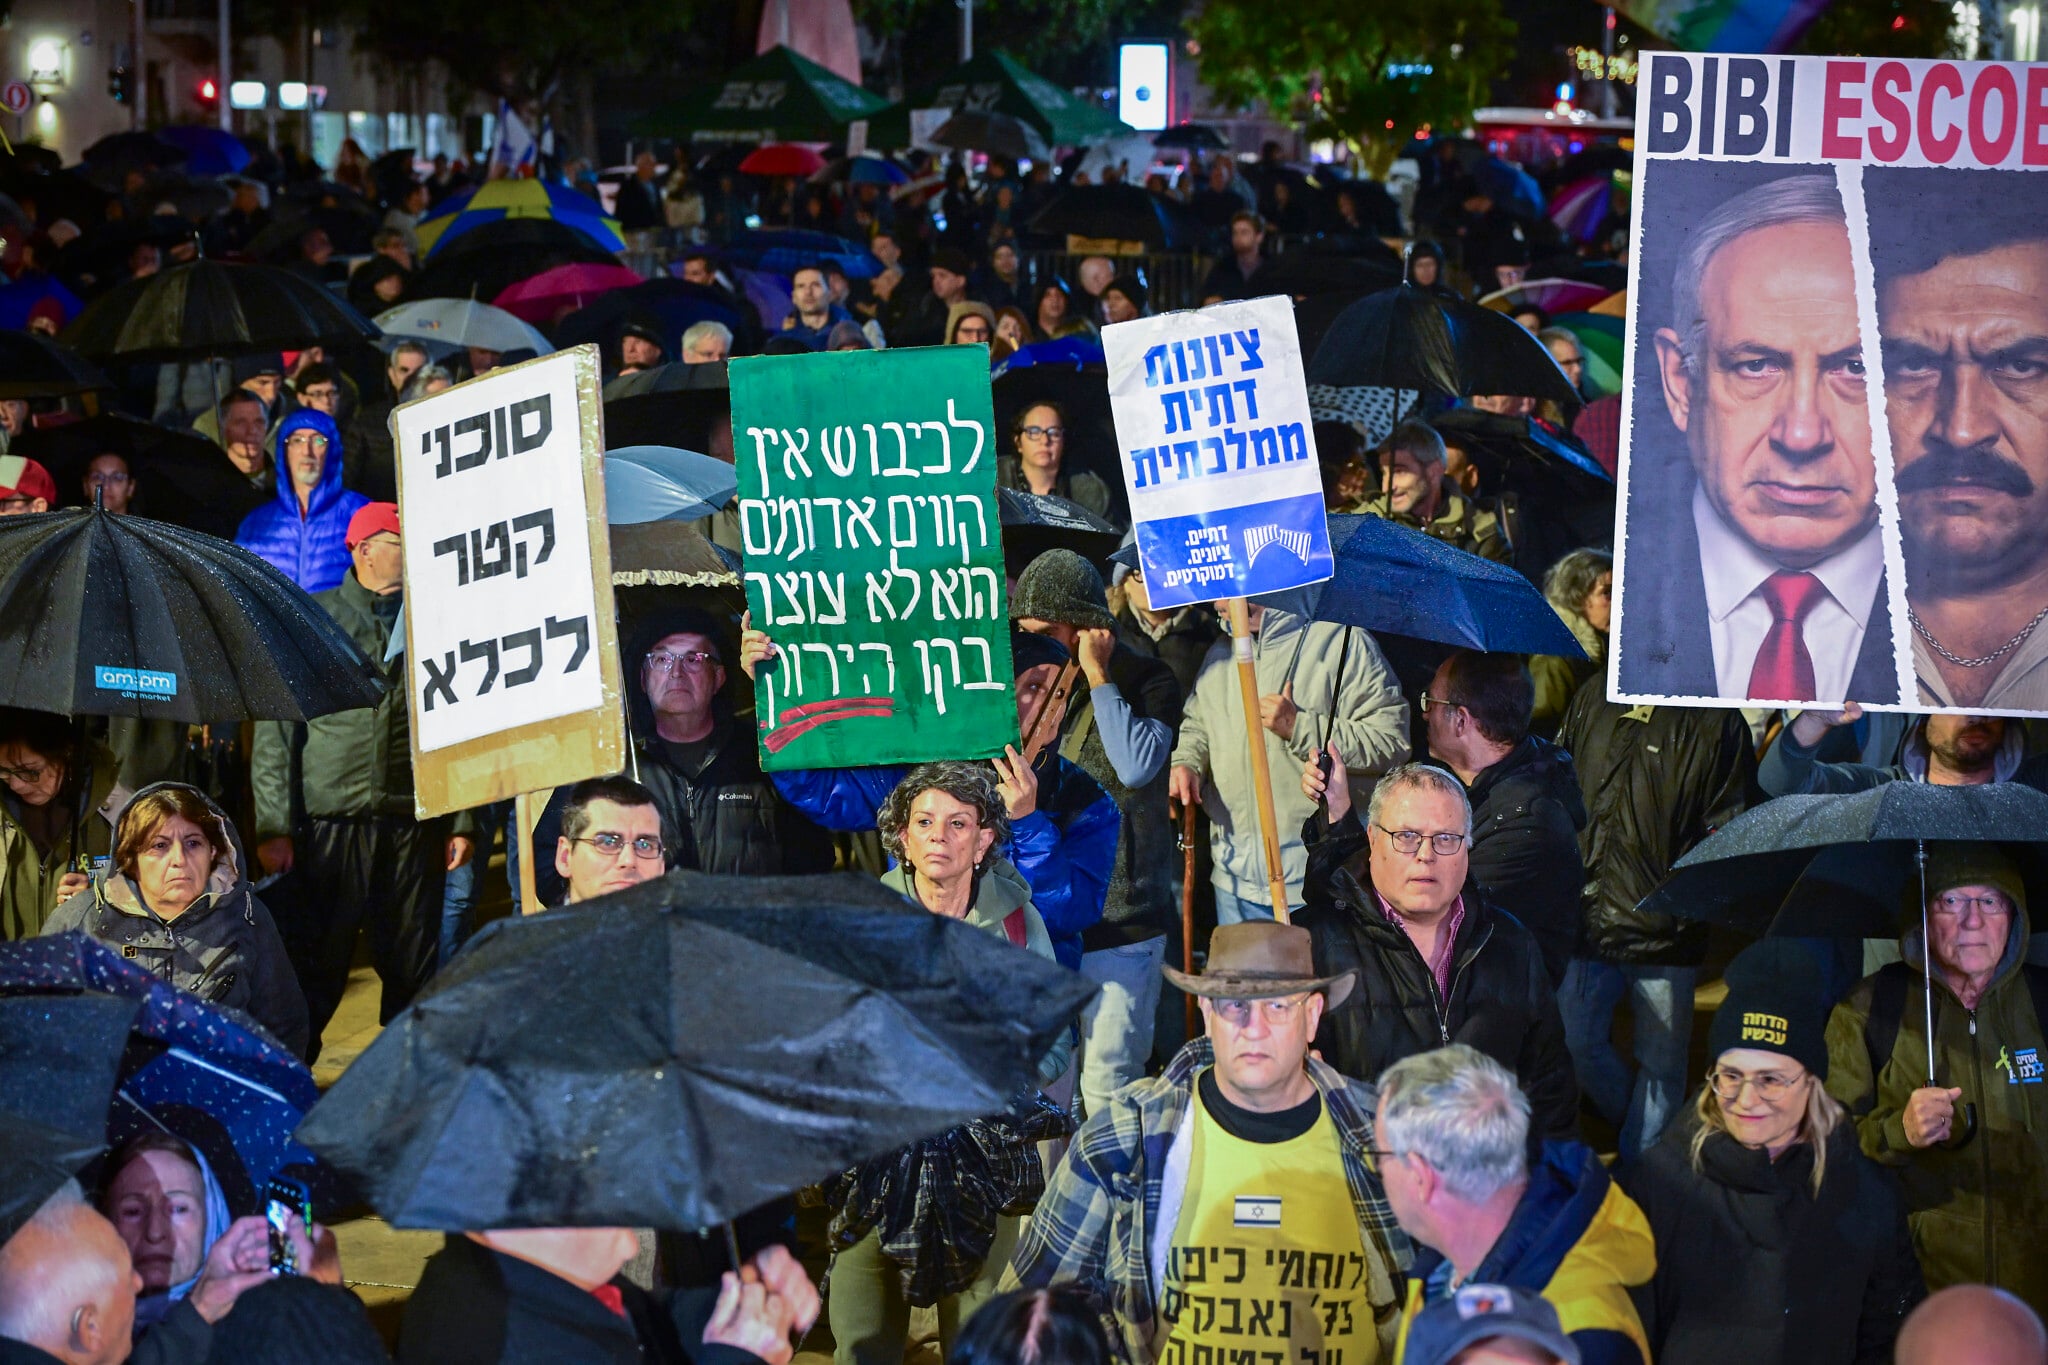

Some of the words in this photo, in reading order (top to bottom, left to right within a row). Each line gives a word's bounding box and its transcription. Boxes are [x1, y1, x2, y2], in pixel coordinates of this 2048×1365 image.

[1646, 55, 1795, 158] BIBI
[1142, 327, 1264, 388] ציונות
[421, 392, 553, 480] סוכני
[1160, 378, 1260, 434] דתית
[746, 426, 813, 499] אין
[820, 398, 985, 478] לכיבוש
[1129, 422, 1309, 489] ממלכתית
[432, 507, 556, 587] קטר
[739, 494, 882, 562] אדומים
[887, 494, 988, 564] קווים
[1184, 524, 1228, 547] דתיים.
[1187, 543, 1232, 566] ציונים.
[744, 570, 847, 626] עוצר
[865, 548, 921, 623] לא
[929, 566, 999, 621] הוא
[1162, 563, 1235, 588] דמוקרטים.
[421, 614, 590, 713] לכלא
[912, 637, 1007, 715] בקו
[139, 693, 171, 702] market
[1742, 1027, 1786, 1045] עכשיו
[1743, 1012, 1788, 1031] הדחה
[1265, 1248, 1364, 1290] לוחמי
[1163, 1285, 1292, 1338] נאבקים
